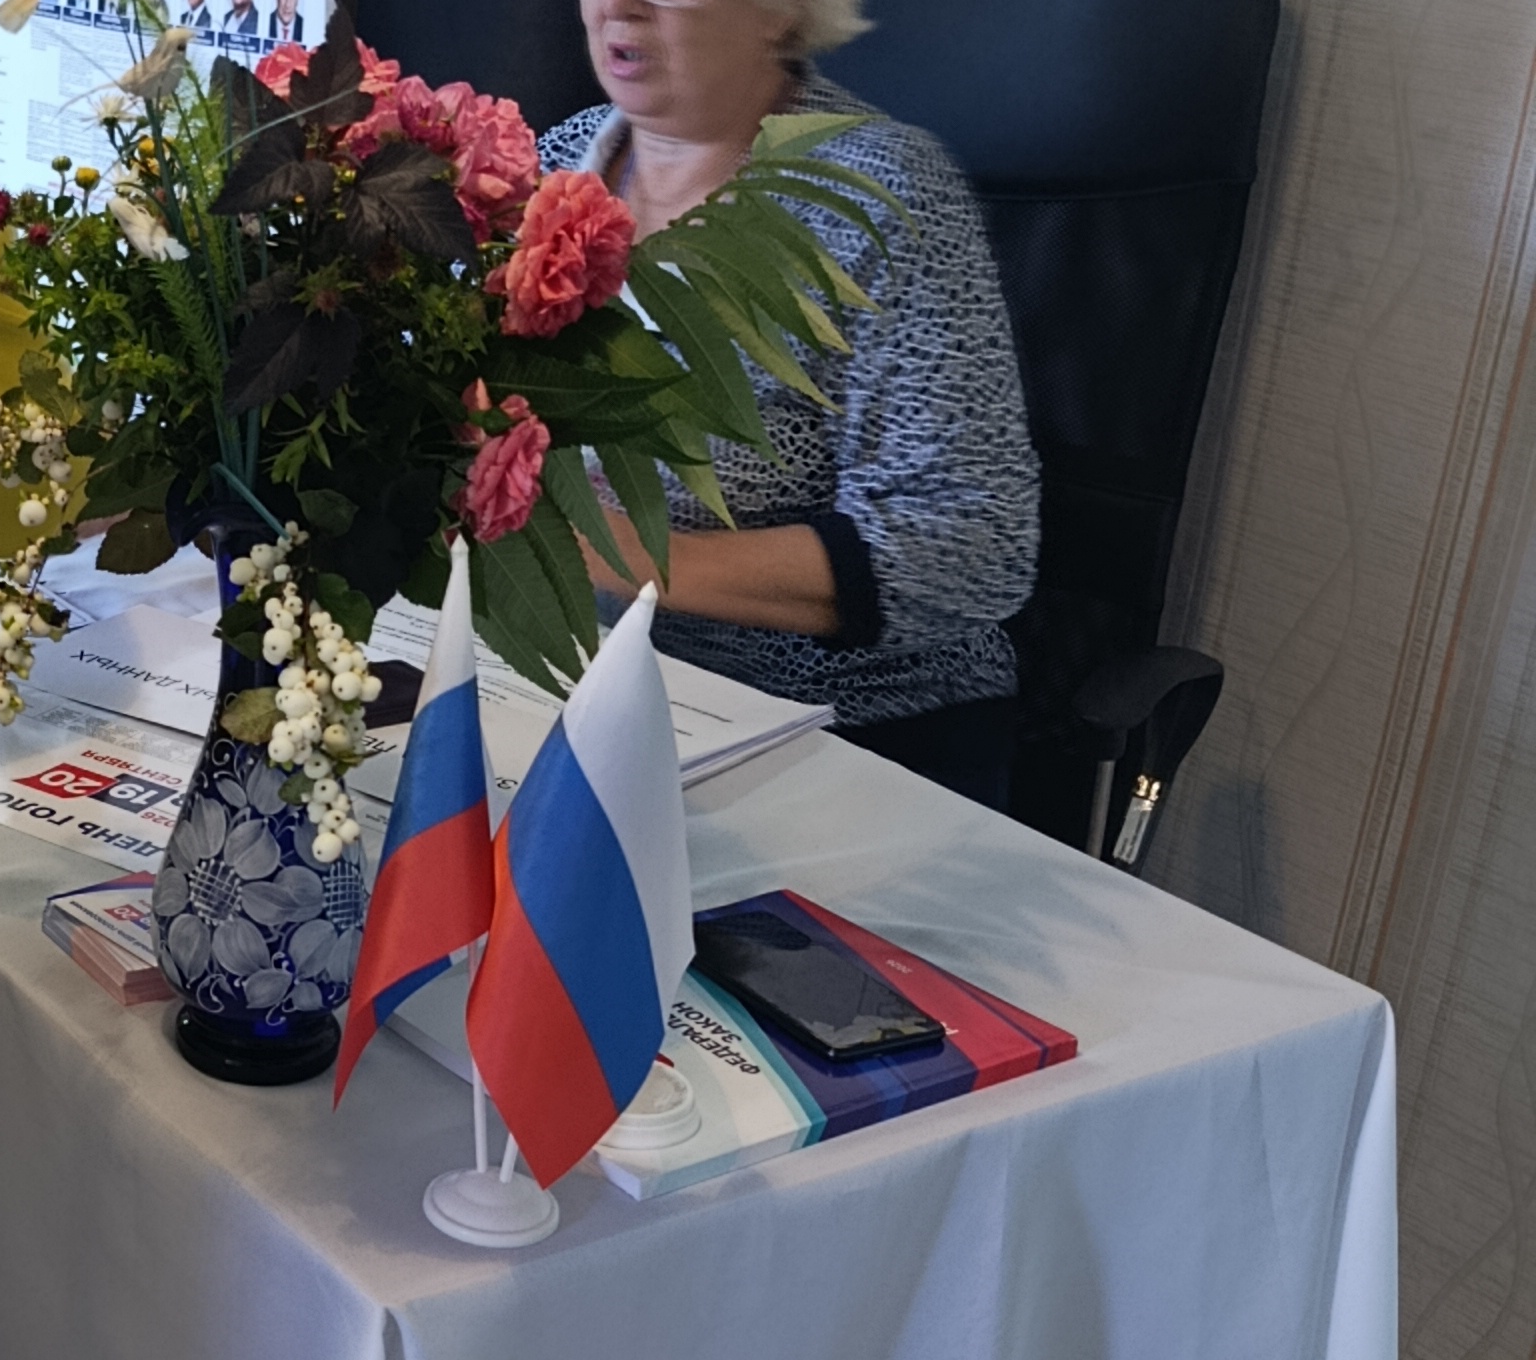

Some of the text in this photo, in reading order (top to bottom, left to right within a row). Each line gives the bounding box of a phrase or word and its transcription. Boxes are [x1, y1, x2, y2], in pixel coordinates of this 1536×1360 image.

[69, 650, 182, 688] ДАННЫХ
[39, 770, 103, 794] 20
[80, 749, 183, 786] СЕНТЯБРЯ
[109, 783, 159, 805] 19
[77, 821, 164, 858] ДЕНЬ
[114, 906, 140, 920] 20
[672, 1001, 742, 1045] ЗАКОН
[666, 1013, 761, 1075] ФЕДЕРАЛ
